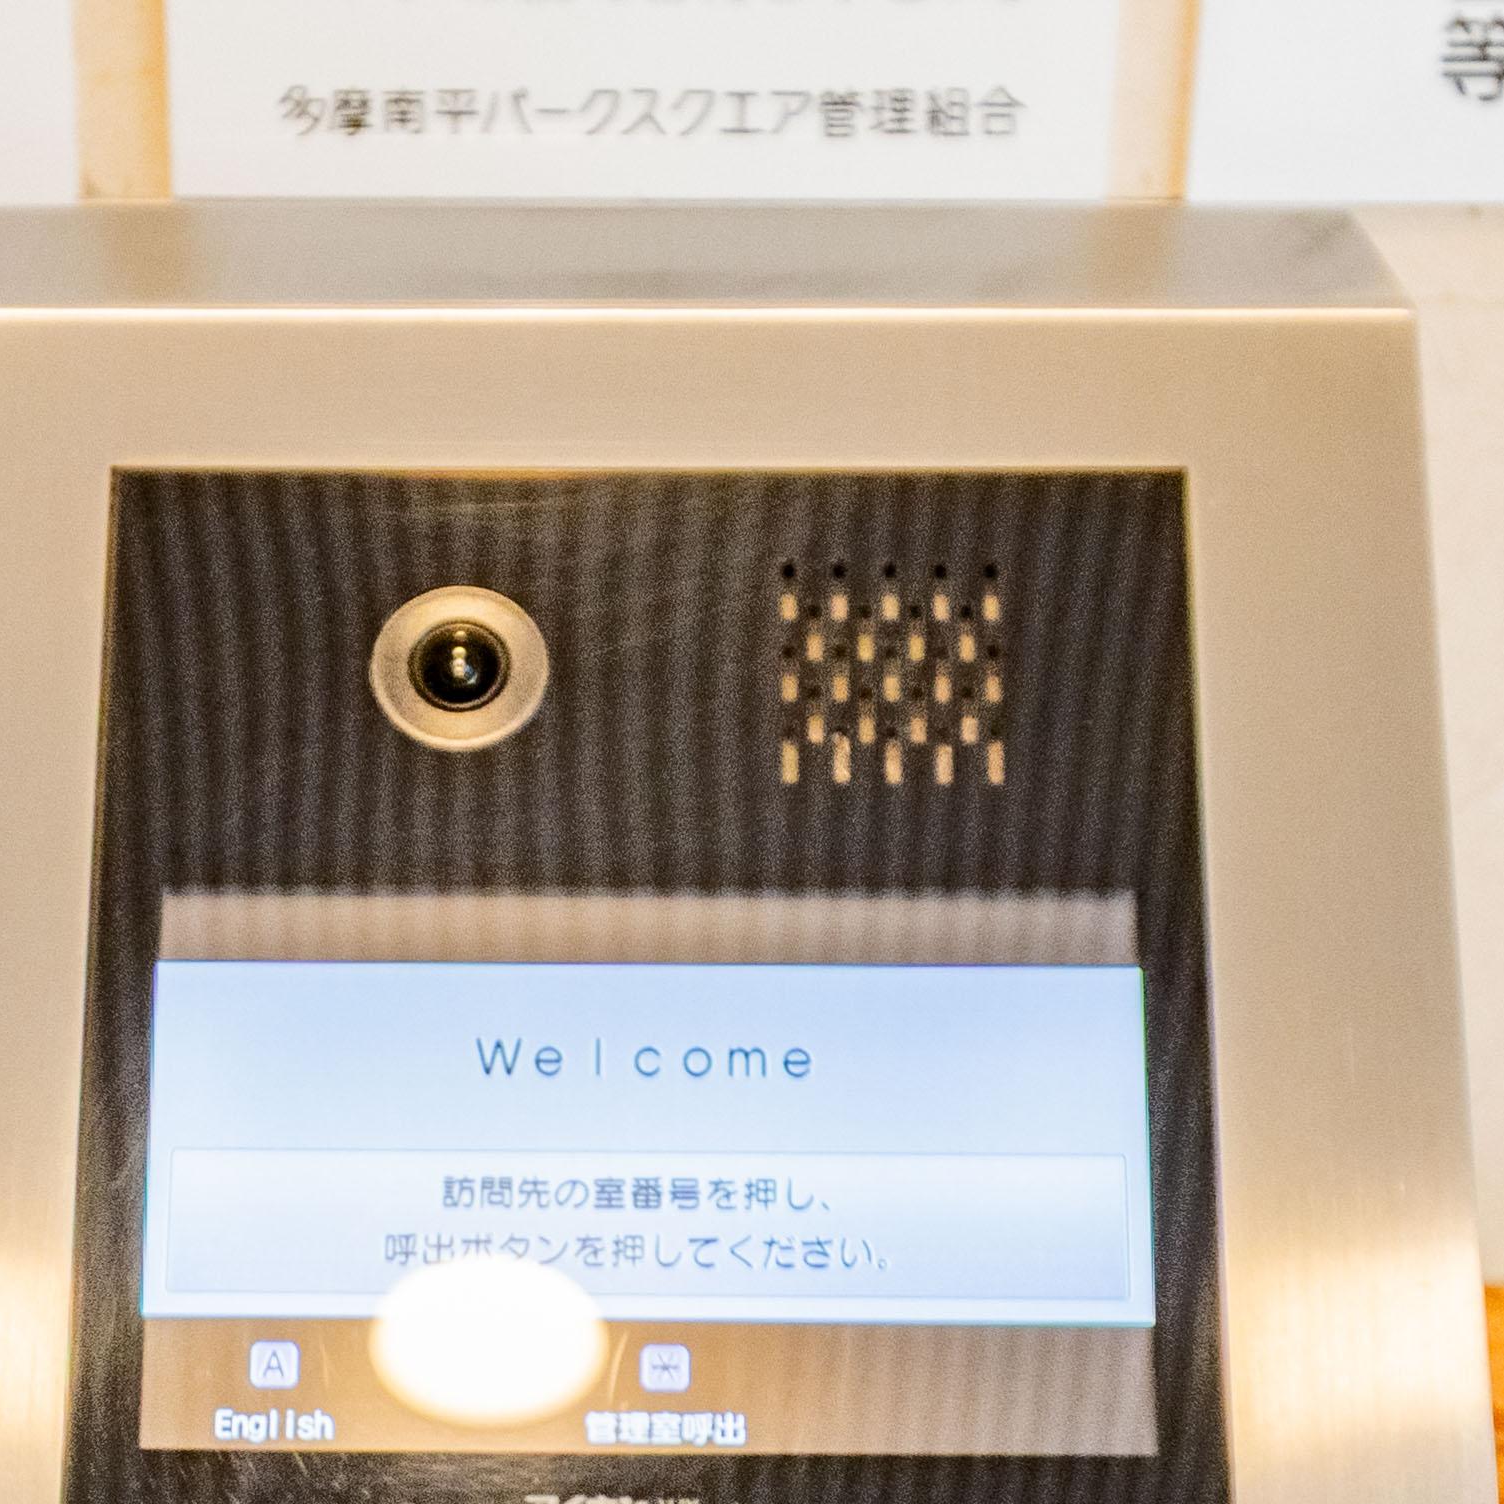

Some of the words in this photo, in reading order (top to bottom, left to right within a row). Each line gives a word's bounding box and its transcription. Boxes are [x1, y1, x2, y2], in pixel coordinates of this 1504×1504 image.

[277, 84, 1027, 138] 多摩南平パークスクエア管理組合
[476, 1036, 813, 1079] Welcome
[441, 1175, 831, 1212] 訪問先の室番号を押し、
[262, 1349, 286, 1379] A
[213, 1408, 336, 1442] English
[585, 1411, 748, 1446] 管理室呼出
